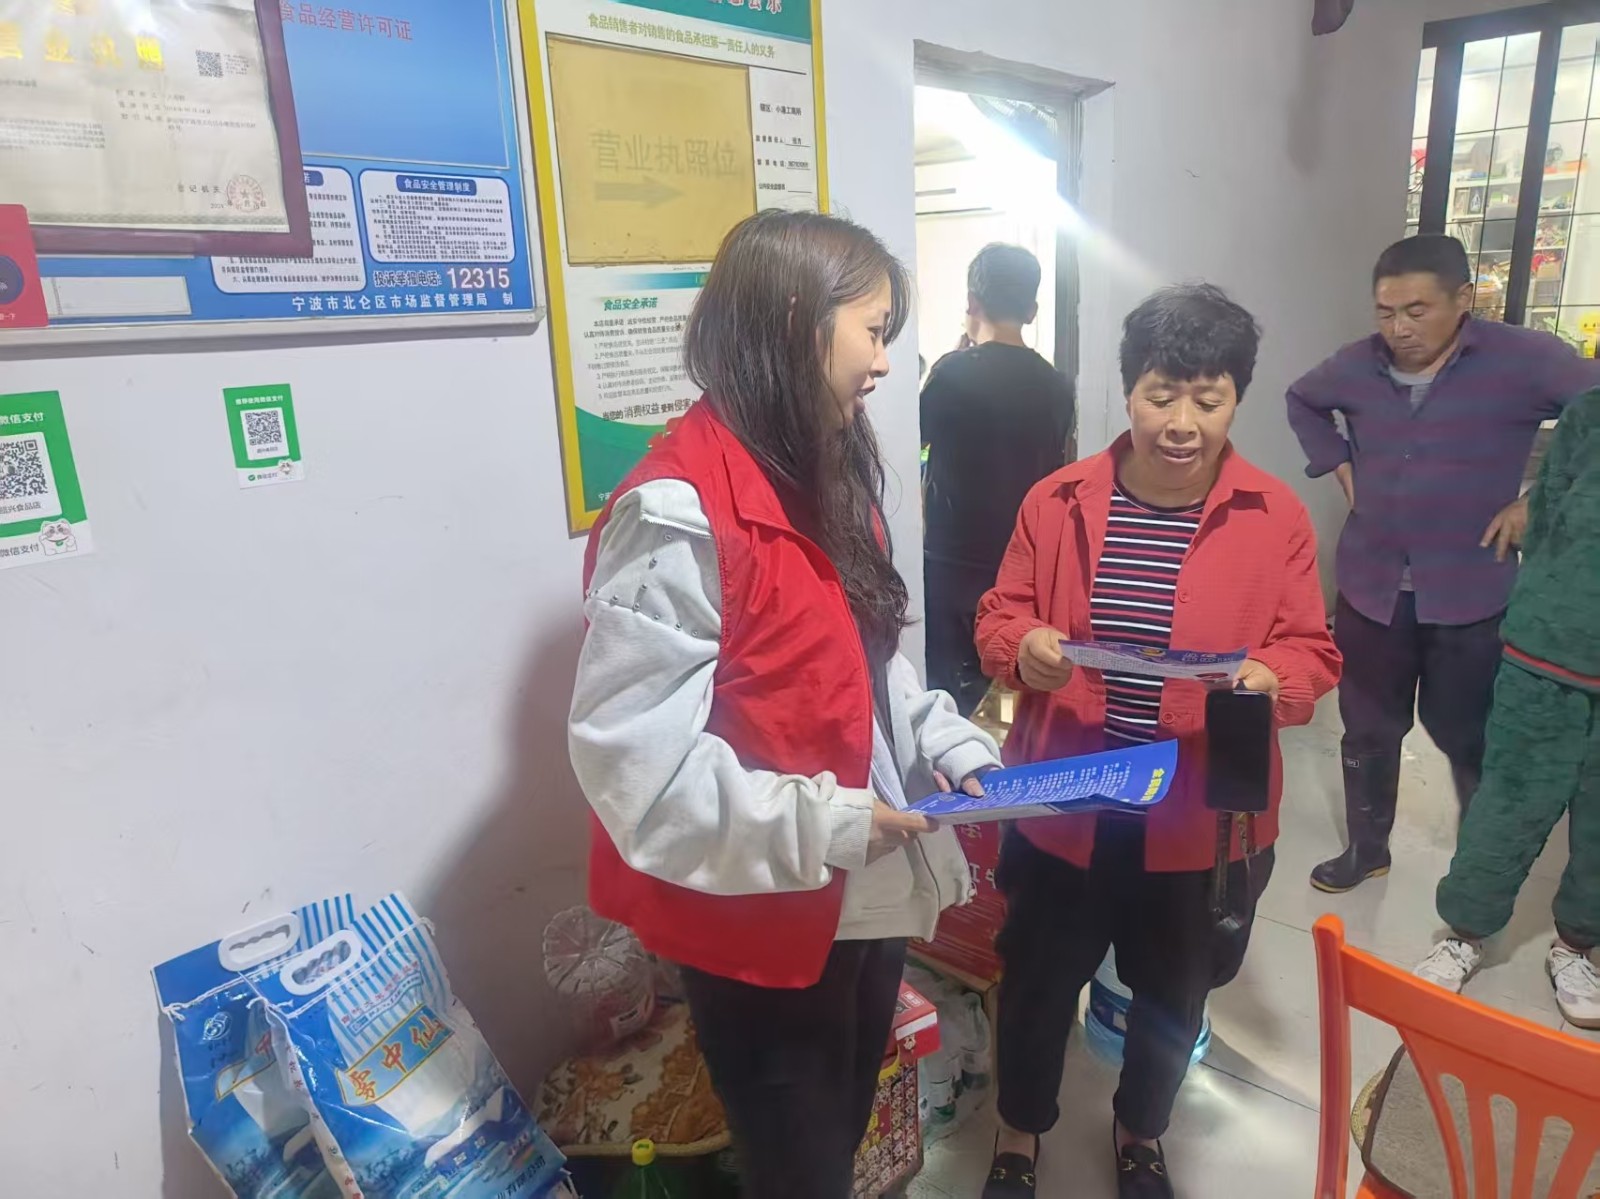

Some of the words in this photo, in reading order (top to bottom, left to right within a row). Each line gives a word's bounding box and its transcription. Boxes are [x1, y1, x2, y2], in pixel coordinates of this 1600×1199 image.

[279, 1, 413, 41] 食品经营许可证
[590, 129, 737, 177] 营业执照位
[404, 178, 471, 193] 食品安全管理制度
[447, 266, 510, 290] 12315
[292, 291, 487, 312] 宁波市北仑区市场监督管理局
[502, 292, 513, 305] 制
[604, 297, 658, 311] 食品安全承诺
[349, 1015, 444, 1100] 雾中仙
